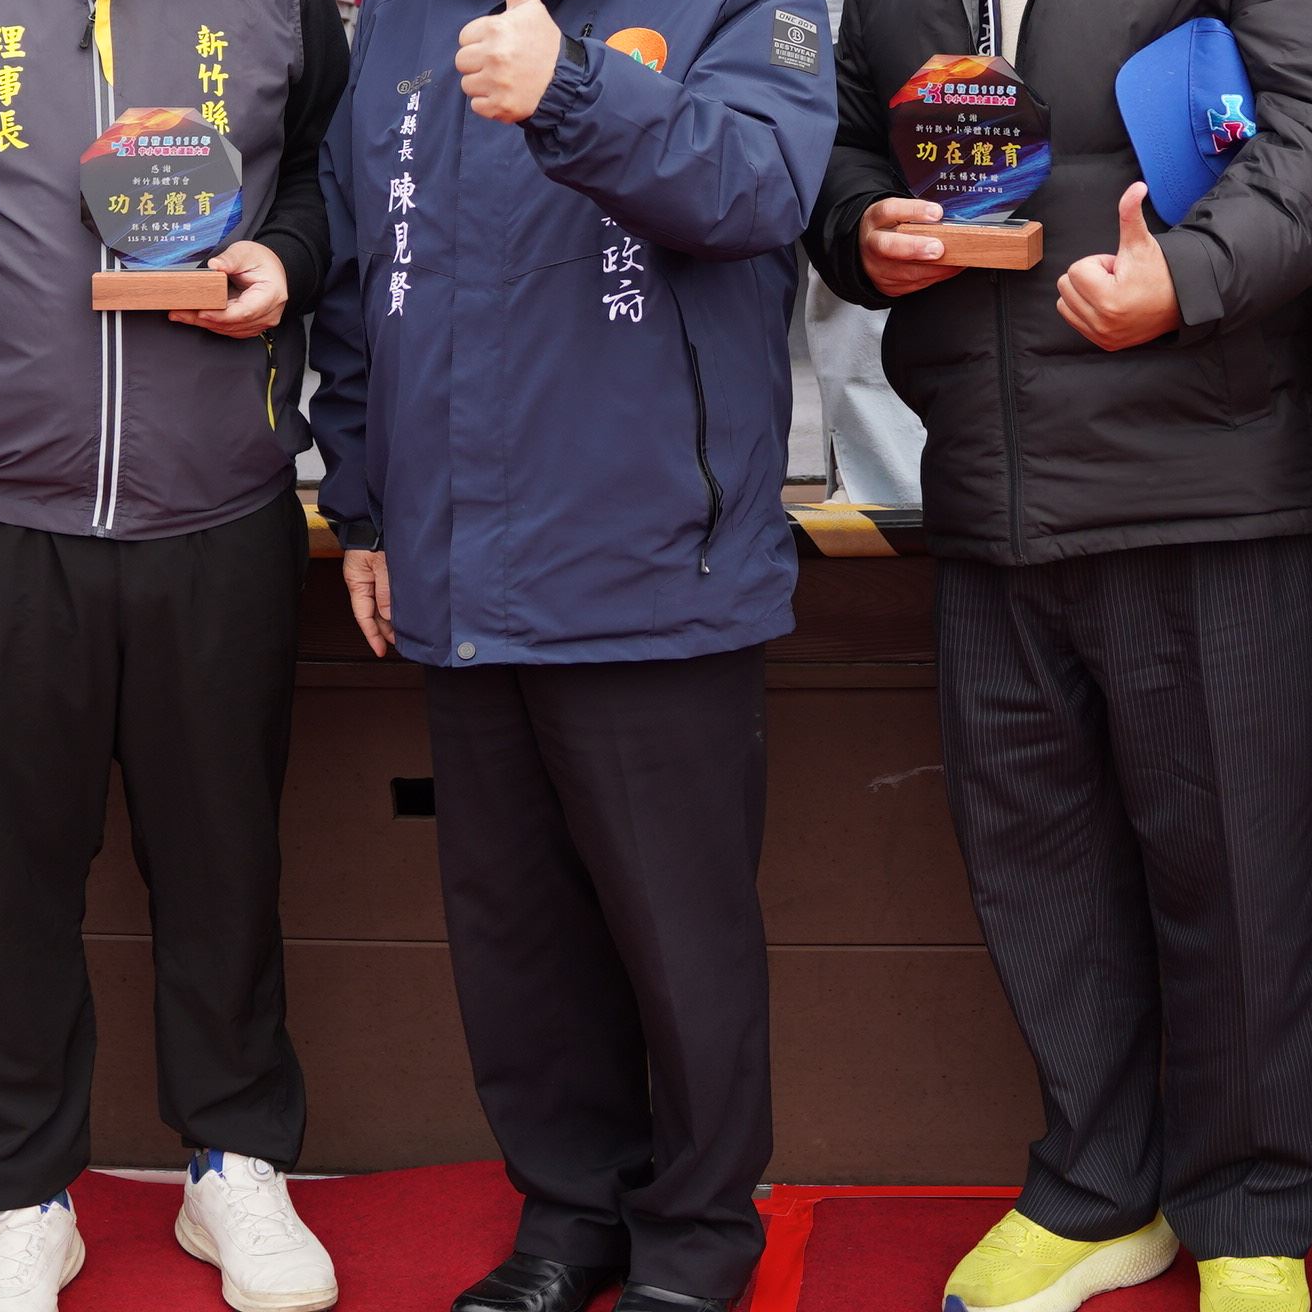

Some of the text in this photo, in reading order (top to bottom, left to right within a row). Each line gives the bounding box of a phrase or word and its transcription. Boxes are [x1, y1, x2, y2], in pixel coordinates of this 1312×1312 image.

[774, 42, 816, 58] BESTWEAR
[195, 24, 231, 135] 新竹縣
[916, 140, 1022, 168] 功在體育
[108, 191, 215, 216] 功在體育
[601, 216, 645, 323] 政府
